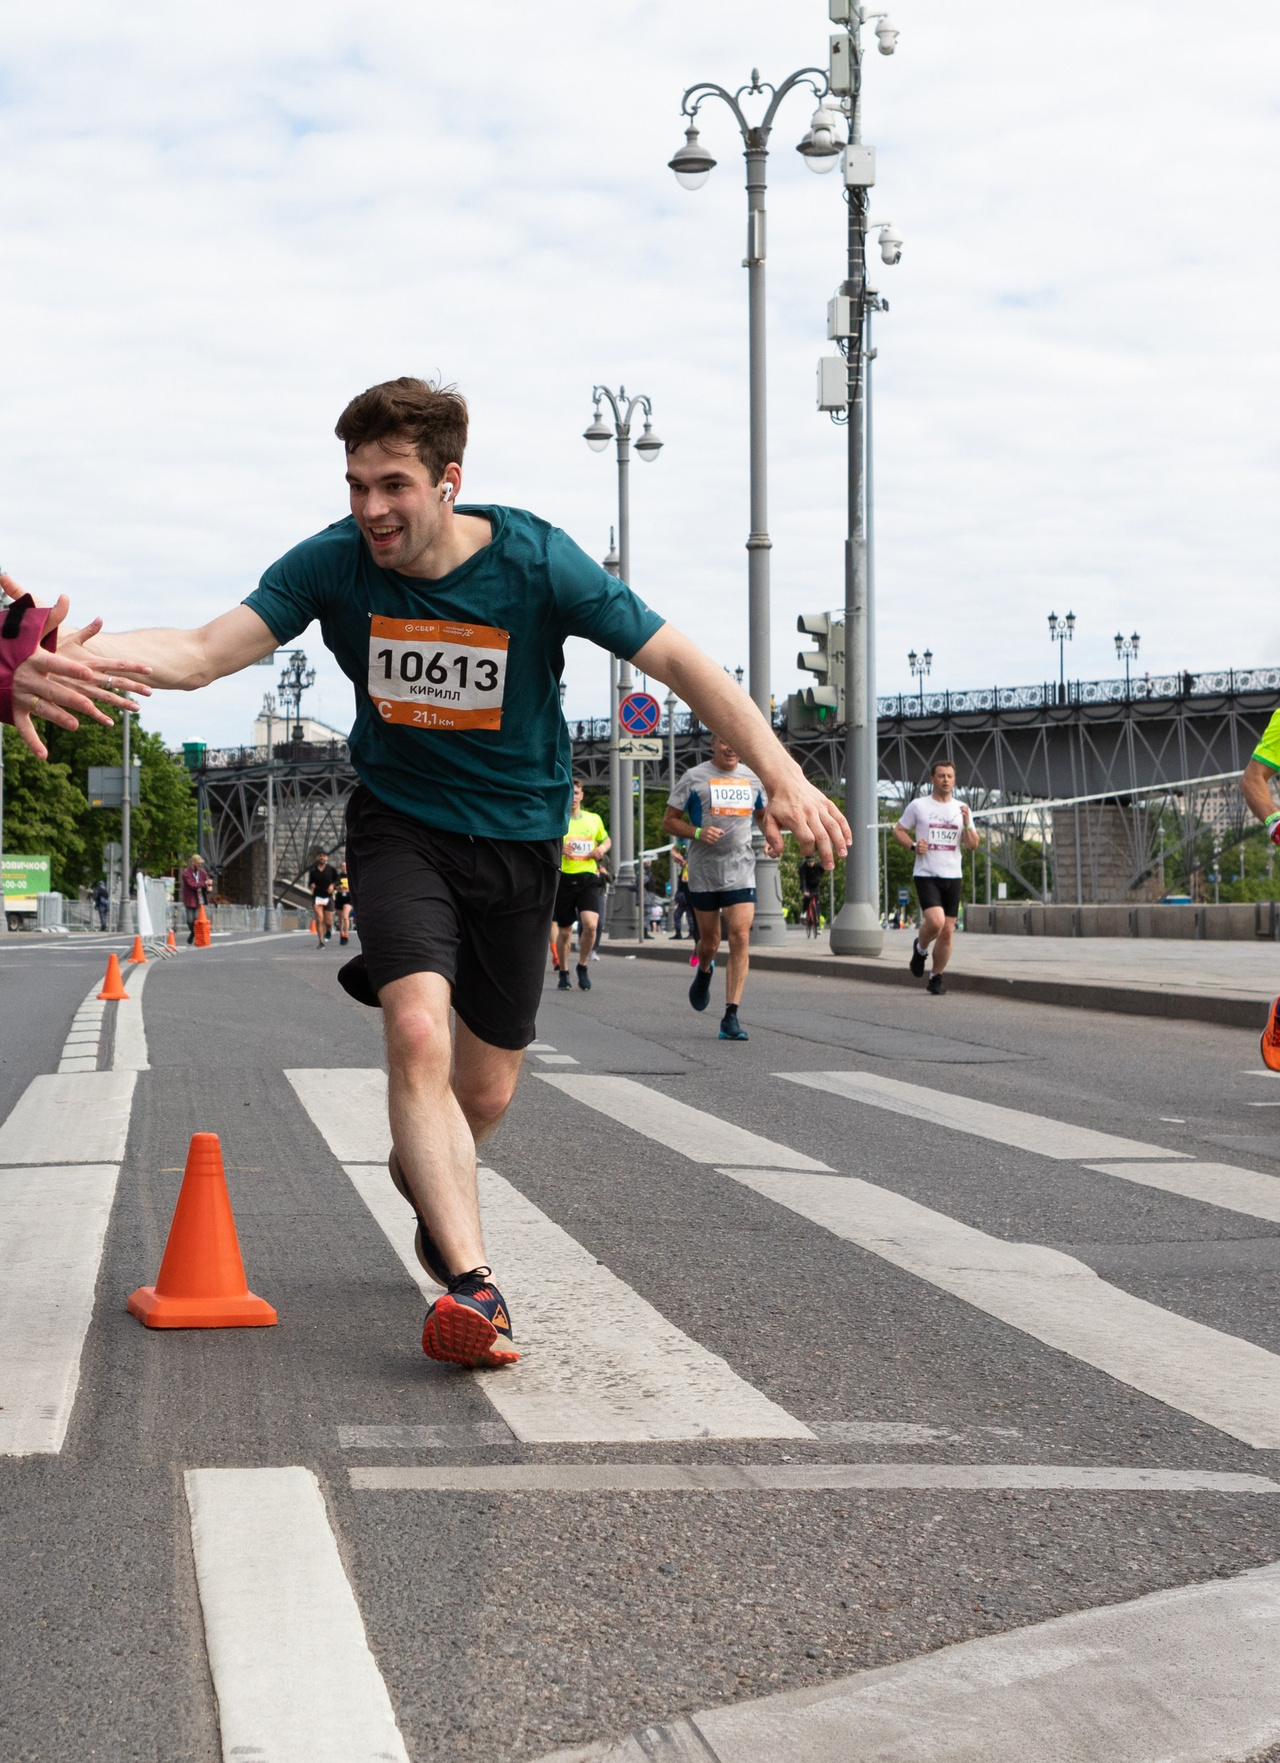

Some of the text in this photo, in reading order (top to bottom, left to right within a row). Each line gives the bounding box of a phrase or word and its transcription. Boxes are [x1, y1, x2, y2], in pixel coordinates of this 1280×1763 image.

[377, 649, 499, 691] 10613
[409, 685, 460, 701] КИРИЛЛ
[412, 710, 438, 725] 21,1
[714, 788, 750, 801] 10285
[931, 830, 957, 841] 11547
